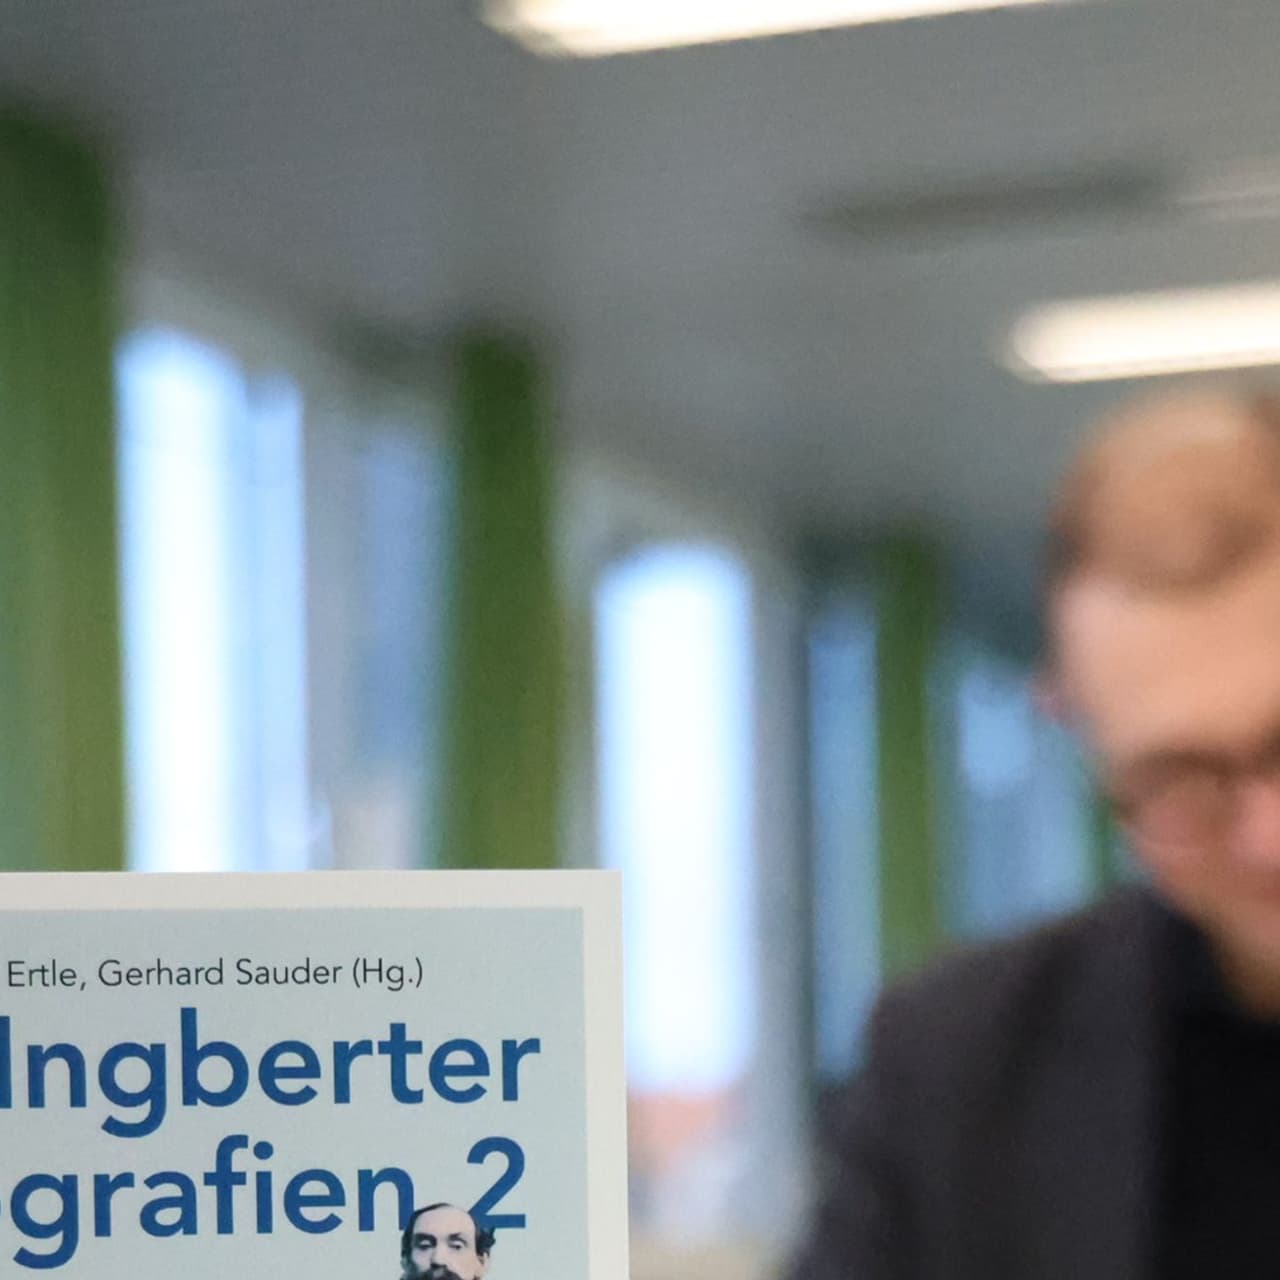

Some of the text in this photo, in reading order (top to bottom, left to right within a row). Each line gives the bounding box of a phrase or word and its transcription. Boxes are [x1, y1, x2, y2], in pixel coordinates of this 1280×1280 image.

[7, 958, 87, 992] Ertle,
[97, 957, 224, 987] Gerhard
[235, 956, 343, 986] Sauder
[352, 956, 423, 992] (Hg.)
[466, 1136, 527, 1229] 2
